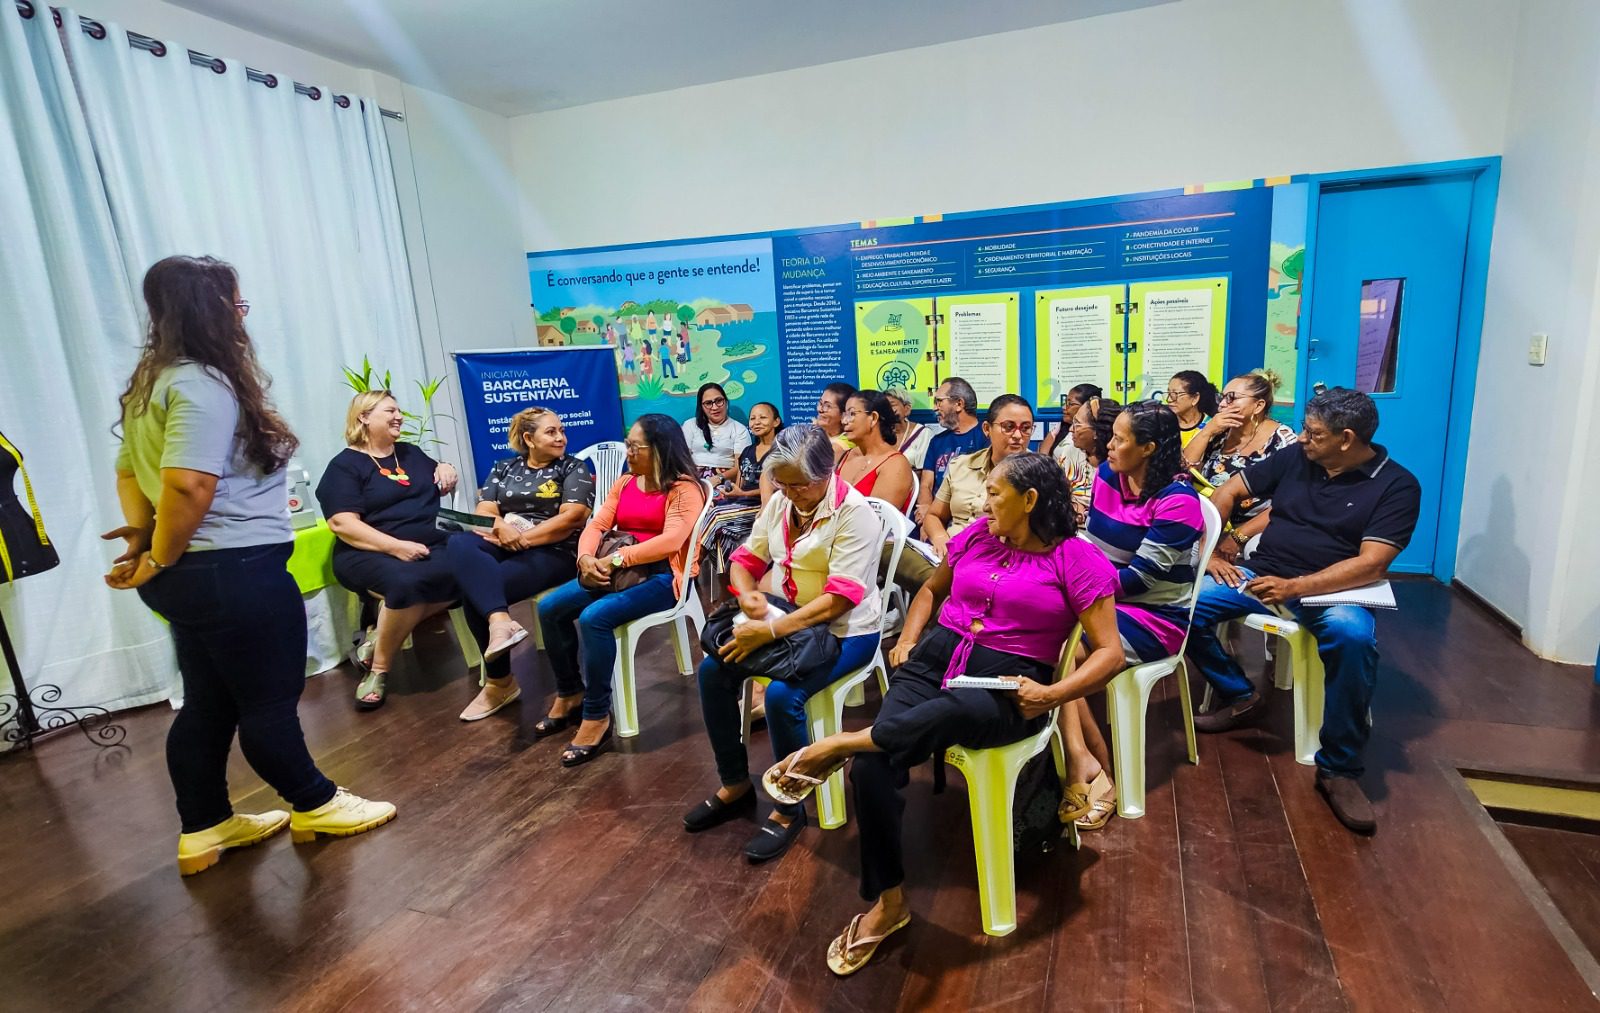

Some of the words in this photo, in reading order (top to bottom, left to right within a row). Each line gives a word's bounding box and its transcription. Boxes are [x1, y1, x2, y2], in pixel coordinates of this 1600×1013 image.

[1133, 229, 1163, 238] PANDEMIA
[851, 238, 878, 248] TEMAS
[984, 243, 1016, 251] MOBILIDADE
[1133, 241, 1181, 250] CONECTIVIDADE
[1185, 237, 1214, 245] INTERNET
[984, 254, 1024, 263] ORDENAMENTO
[1061, 248, 1093, 256] HABITAÇÃO
[1133, 252, 1171, 262] INSTITUIÇÕES
[781, 258, 810, 268] TEORIA
[813, 256, 826, 265] DA
[861, 259, 906, 268] DESENVOLVIMENTO
[906, 256, 937, 264] ECONÔMICO
[547, 270, 555, 287] É
[557, 269, 622, 286] conversando
[625, 271, 646, 287] que
[648, 271, 655, 280] a
[657, 267, 689, 284] gente
[692, 267, 704, 277] se
[707, 257, 761, 276] entende!
[782, 268, 826, 279] MUDANÇA
[984, 266, 1016, 274] SEGURANÇA
[1150, 299, 1166, 307] Ações
[1166, 297, 1189, 306] possíveis
[1074, 304, 1098, 313] desejado
[875, 347, 919, 355] SANEAMENTO
[481, 370, 529, 379] INICIATIVA
[482, 377, 569, 392] BARCARENA
[484, 387, 580, 404] SUSTENTÁVEL
[570, 410, 591, 418] social
